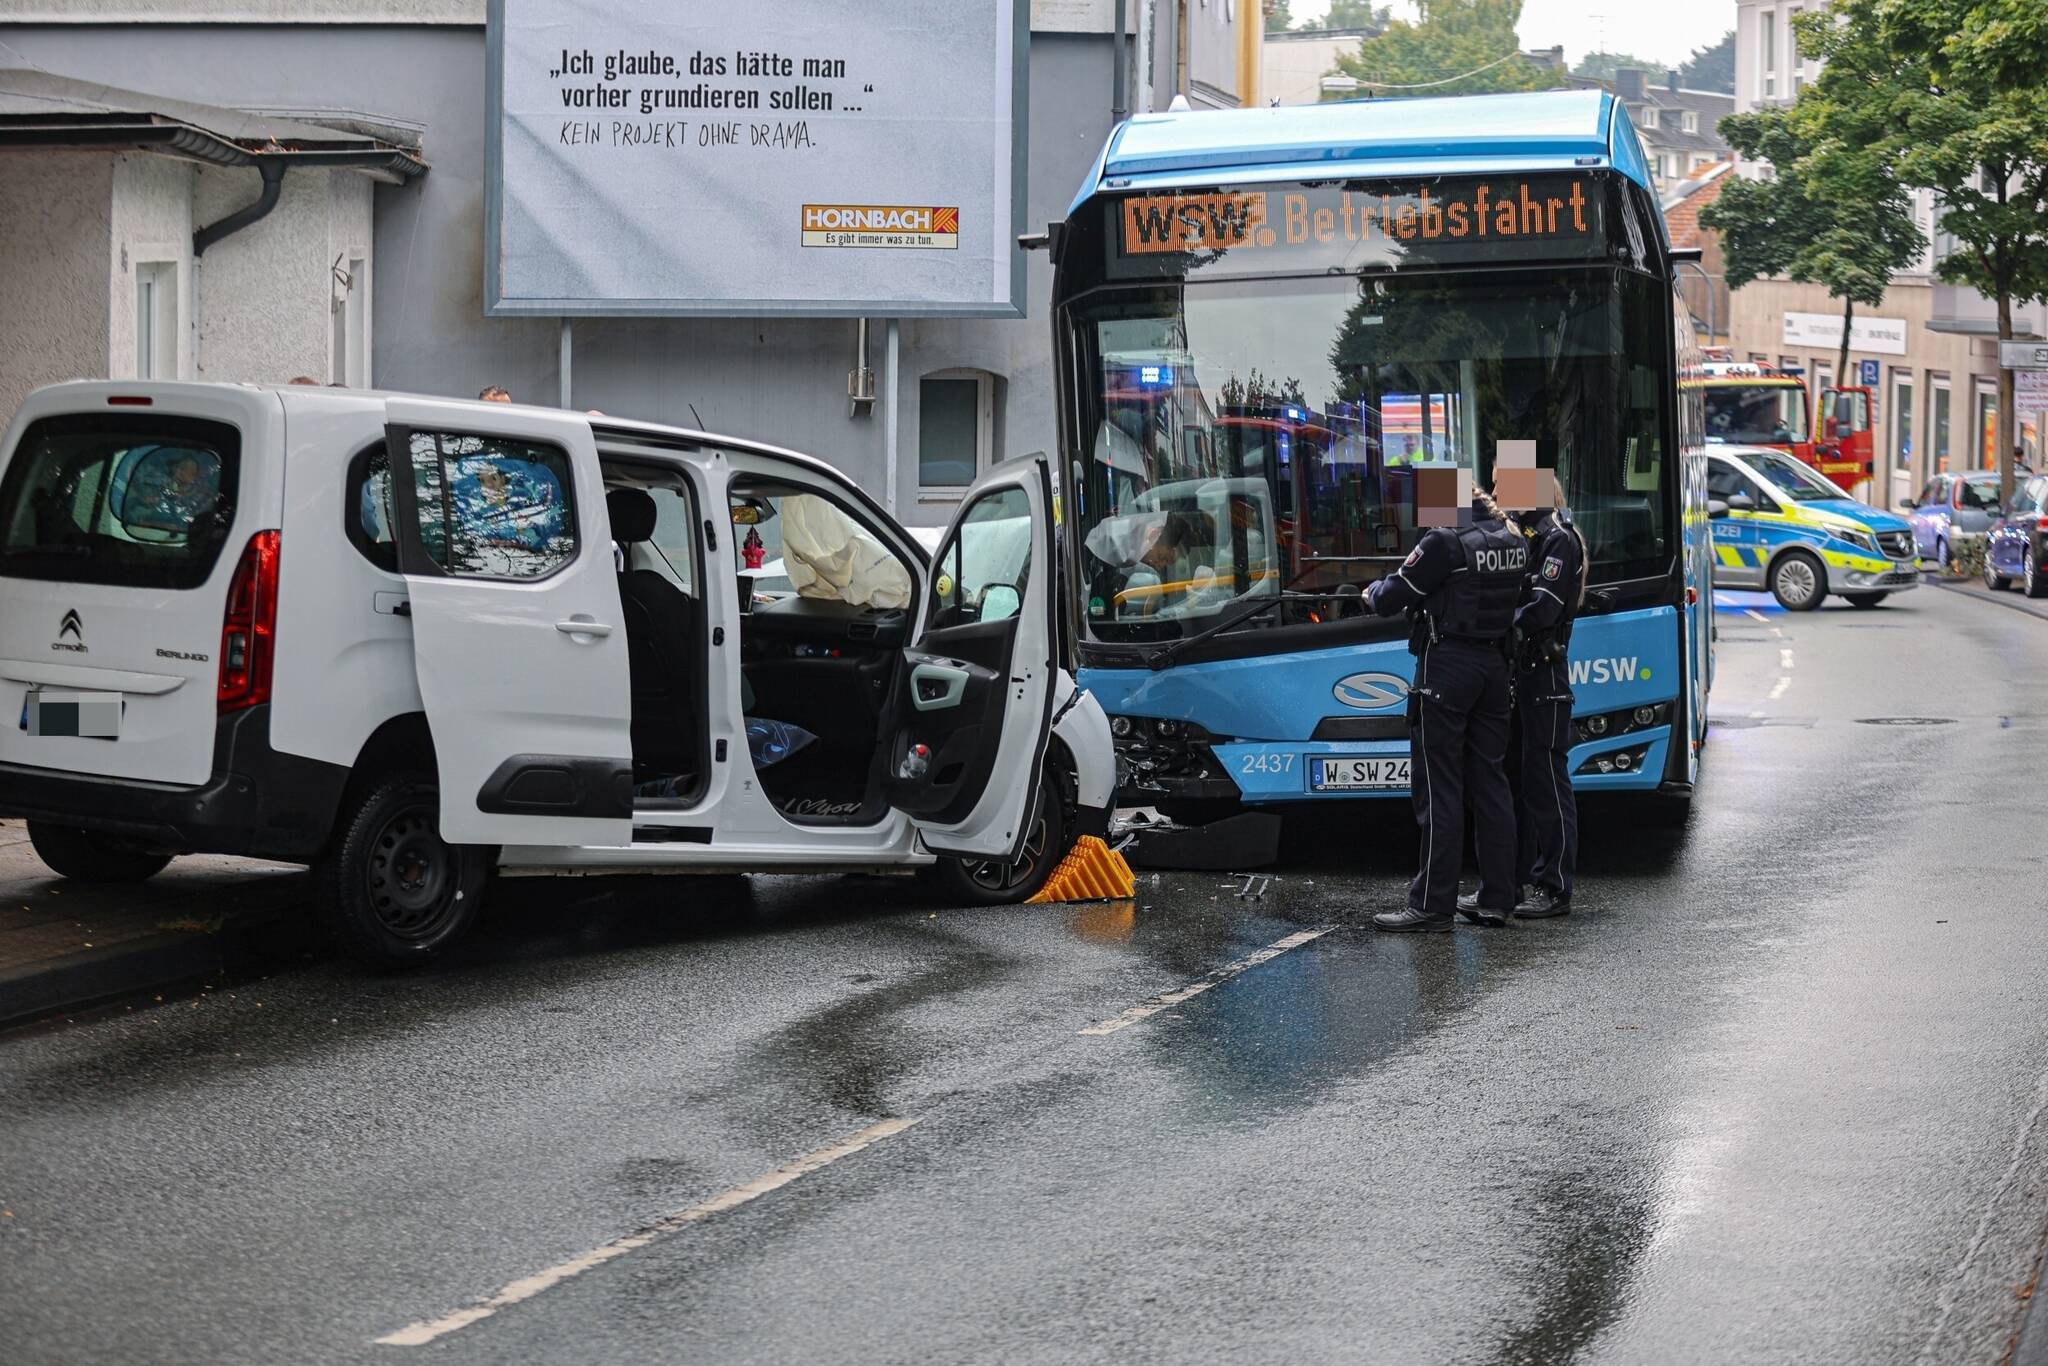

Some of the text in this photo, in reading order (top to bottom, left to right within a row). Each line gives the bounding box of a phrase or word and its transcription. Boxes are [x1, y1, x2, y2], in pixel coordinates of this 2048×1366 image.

[603, 50, 681, 81] glaube,
[689, 50, 727, 76] das
[736, 51, 793, 77] hätte
[802, 57, 846, 78] man
[561, 83, 632, 108] vorher
[640, 83, 759, 114] grundieren
[769, 85, 833, 111] sollen
[560, 120, 817, 149] KEIN PROJEKT OHNE DRAMA.
[806, 208, 930, 230] HORNBACH
[1284, 181, 1587, 244] Betriebsfahrt
[826, 232, 934, 246] Es gibt immer was zu tun.
[1712, 524, 1742, 538] IZEI
[1475, 547, 1527, 572] POLIZEI
[155, 648, 209, 663] BERLINGO
[1242, 753, 1296, 774] 2437
[1325, 762, 1338, 783] W
[1353, 761, 1379, 782] SW
